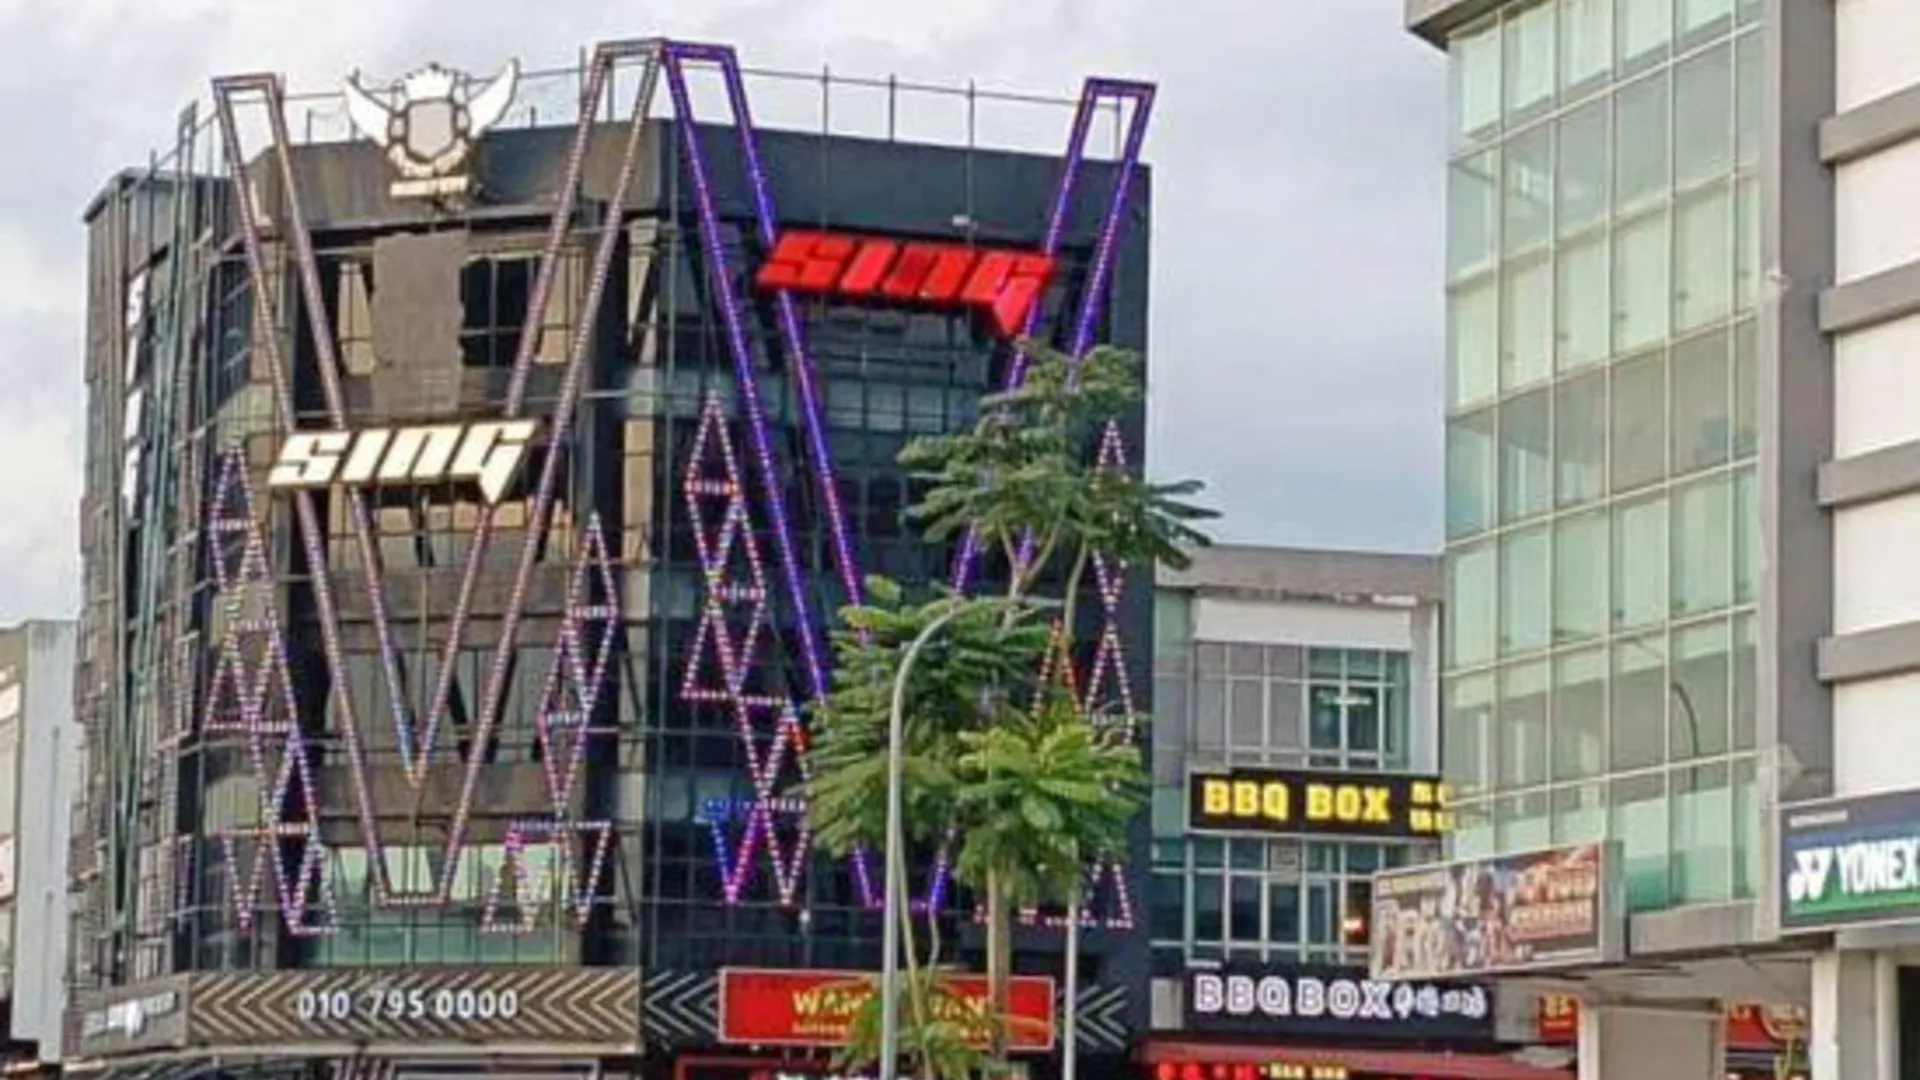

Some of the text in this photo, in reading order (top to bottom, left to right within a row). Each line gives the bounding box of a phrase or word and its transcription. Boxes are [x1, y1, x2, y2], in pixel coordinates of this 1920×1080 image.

[1203, 781, 1289, 820] BBQ
[1306, 784, 1390, 822] BOX
[1834, 838, 1920, 895] YONEX
[299, 989, 519, 1020] 010 795 0000
[1194, 974, 1291, 1014] BBQ
[1295, 977, 1391, 1018] BOX
